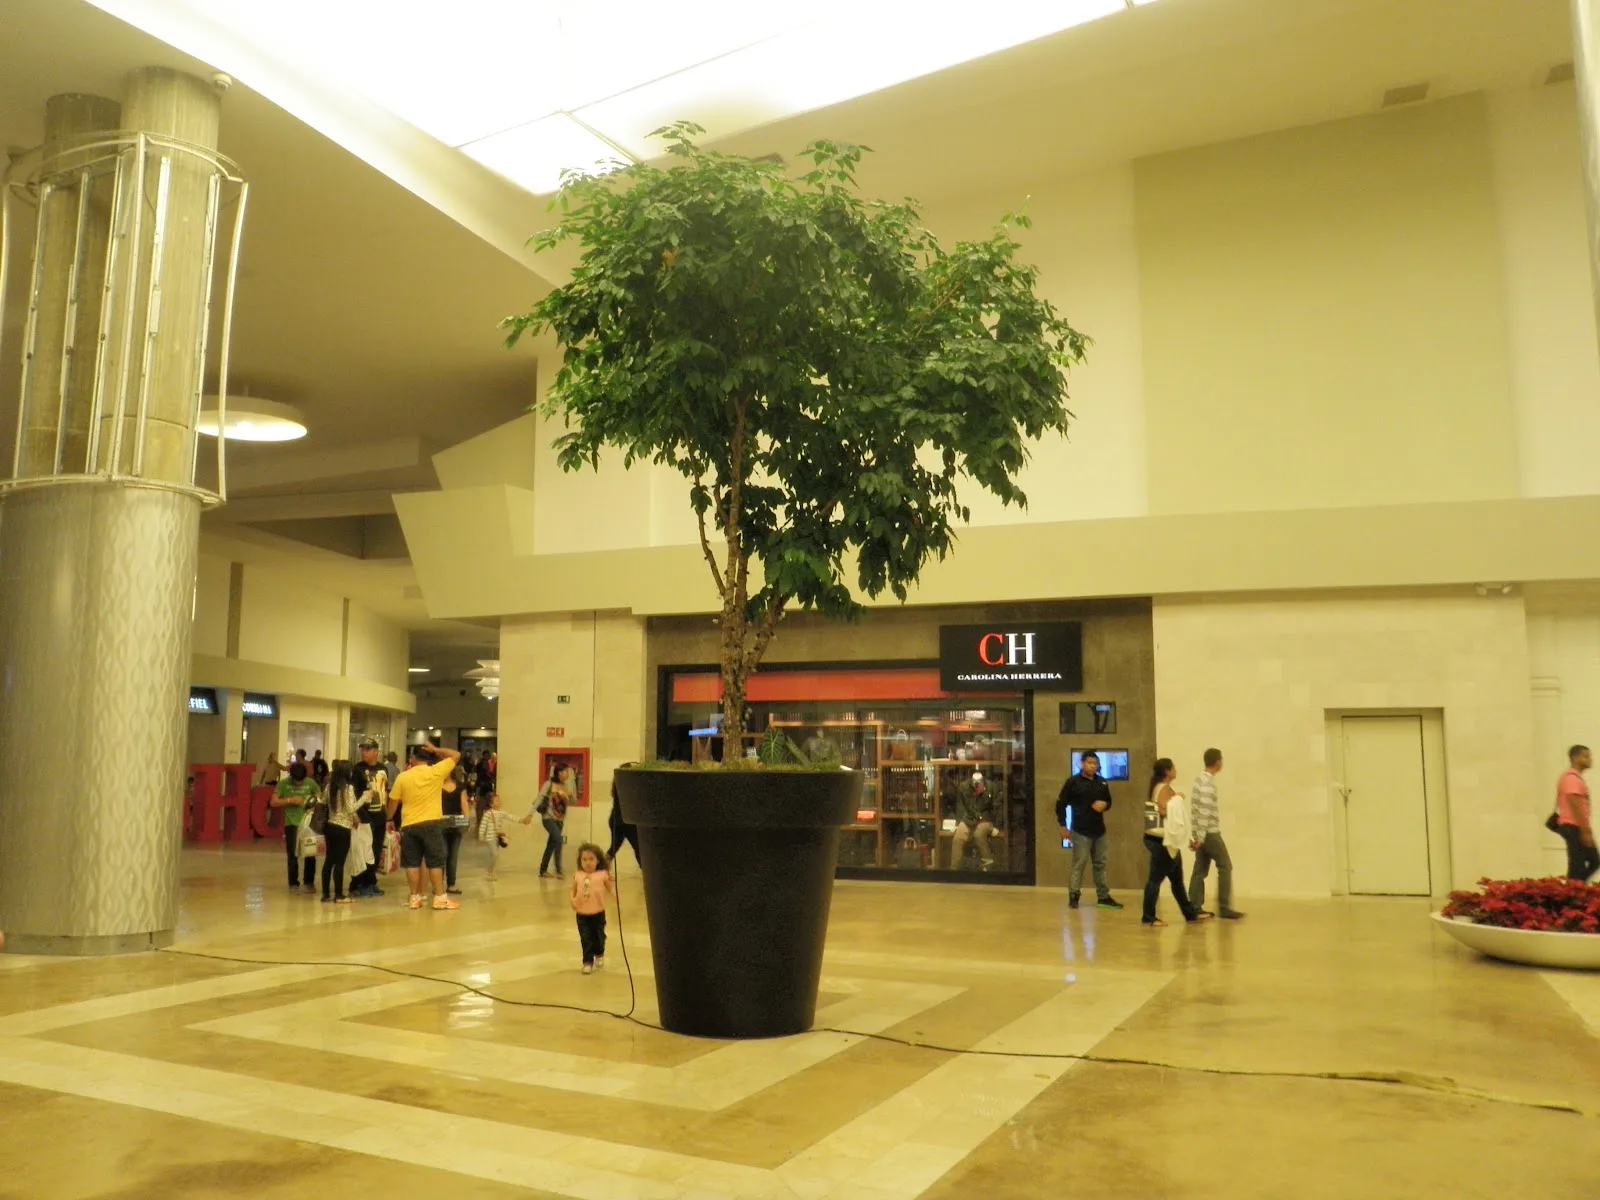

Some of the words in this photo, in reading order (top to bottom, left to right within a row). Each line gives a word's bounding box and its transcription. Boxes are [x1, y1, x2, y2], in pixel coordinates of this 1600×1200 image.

[978, 632, 1036, 666] CH
[957, 673, 1009, 681] CAROLINA
[1010, 672, 1062, 680] HERRERA
